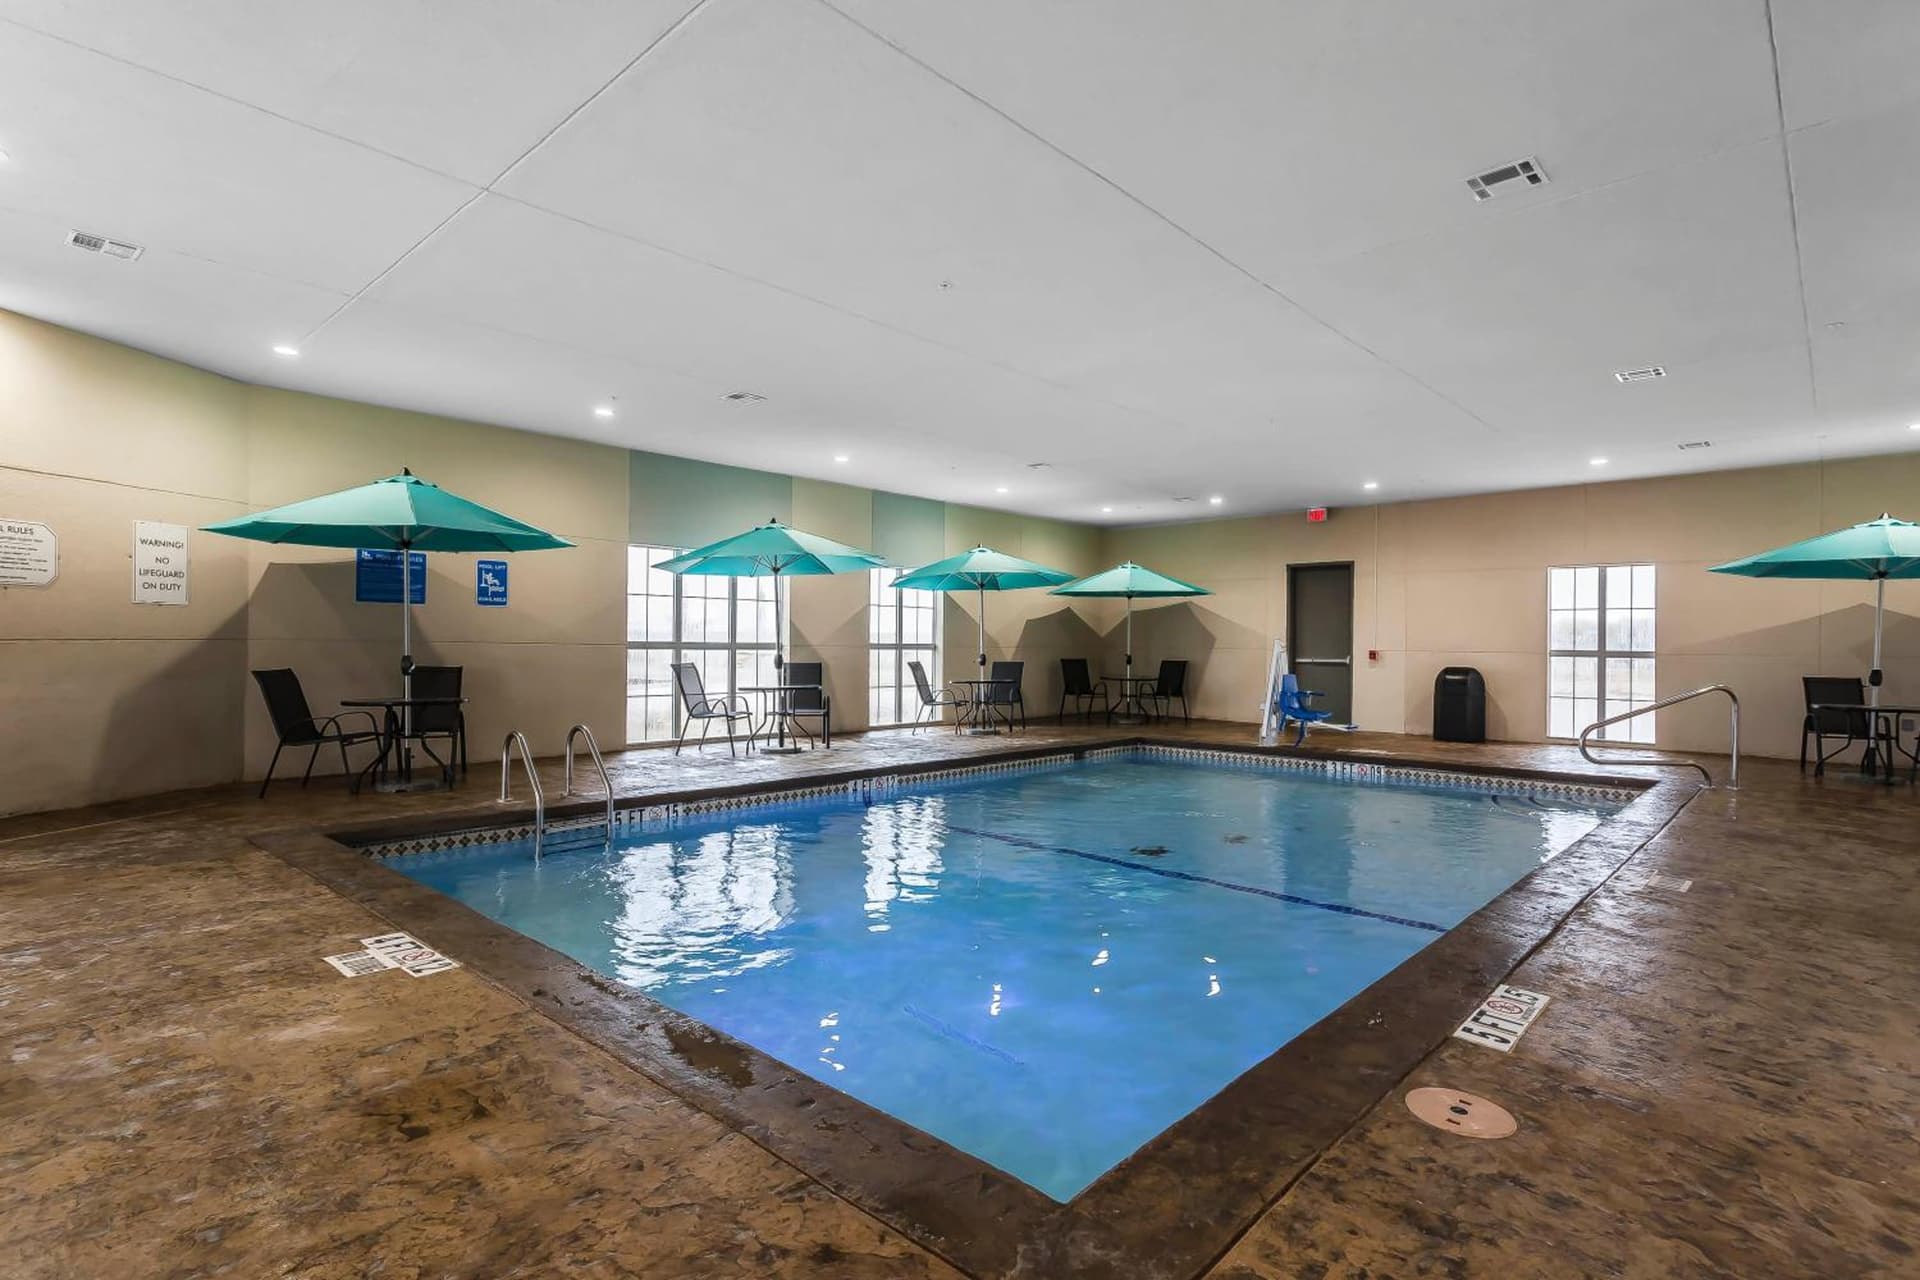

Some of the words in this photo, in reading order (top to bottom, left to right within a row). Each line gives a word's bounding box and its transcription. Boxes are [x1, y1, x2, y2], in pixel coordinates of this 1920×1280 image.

[8, 525, 35, 535] RULES
[139, 538, 185, 549] WARNING!
[155, 556, 170, 565] NO
[139, 568, 185, 579] LIFEGUARD
[142, 582, 157, 591] ON
[159, 582, 182, 591] DUTY
[1331, 761, 1337, 773] 3
[1342, 762, 1355, 774] FT
[615, 811, 622, 825] 5
[629, 808, 645, 825] FT
[1471, 1009, 1525, 1034] FT
[1461, 1026, 1511, 1044] 5
